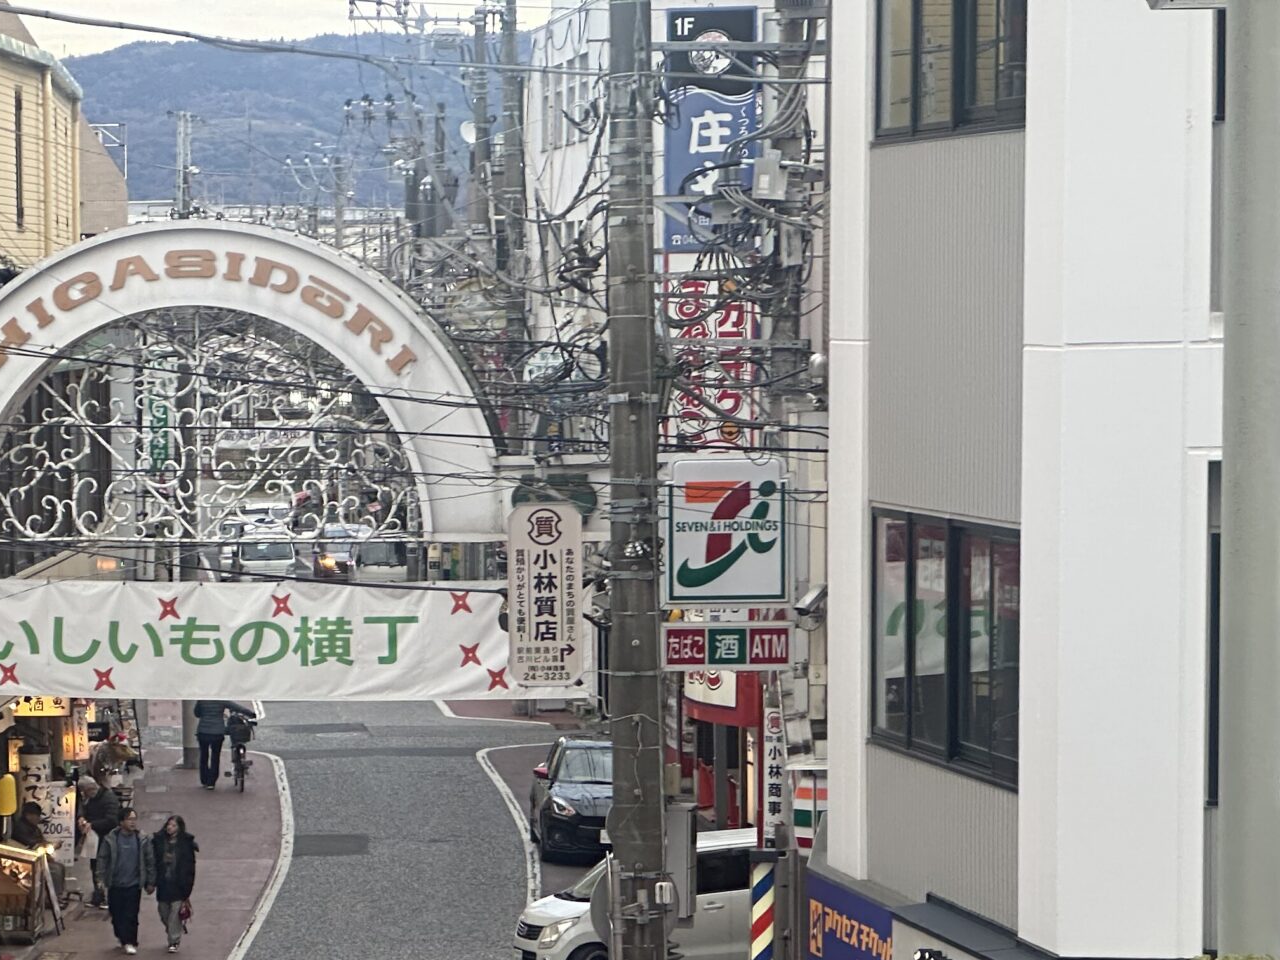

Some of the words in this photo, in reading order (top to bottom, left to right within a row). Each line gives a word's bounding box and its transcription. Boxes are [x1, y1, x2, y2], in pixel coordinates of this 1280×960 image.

[675, 17, 695, 36] 1F
[724, 520, 778, 532] HOLDINGS
[533, 549, 558, 641] 小林質店
[668, 636, 704, 659] たばこ
[715, 635, 739, 659] 酒
[752, 635, 786, 658] ATM
[523, 672, 570, 681] 24-3233
[768, 745, 783, 817] 小林商事
